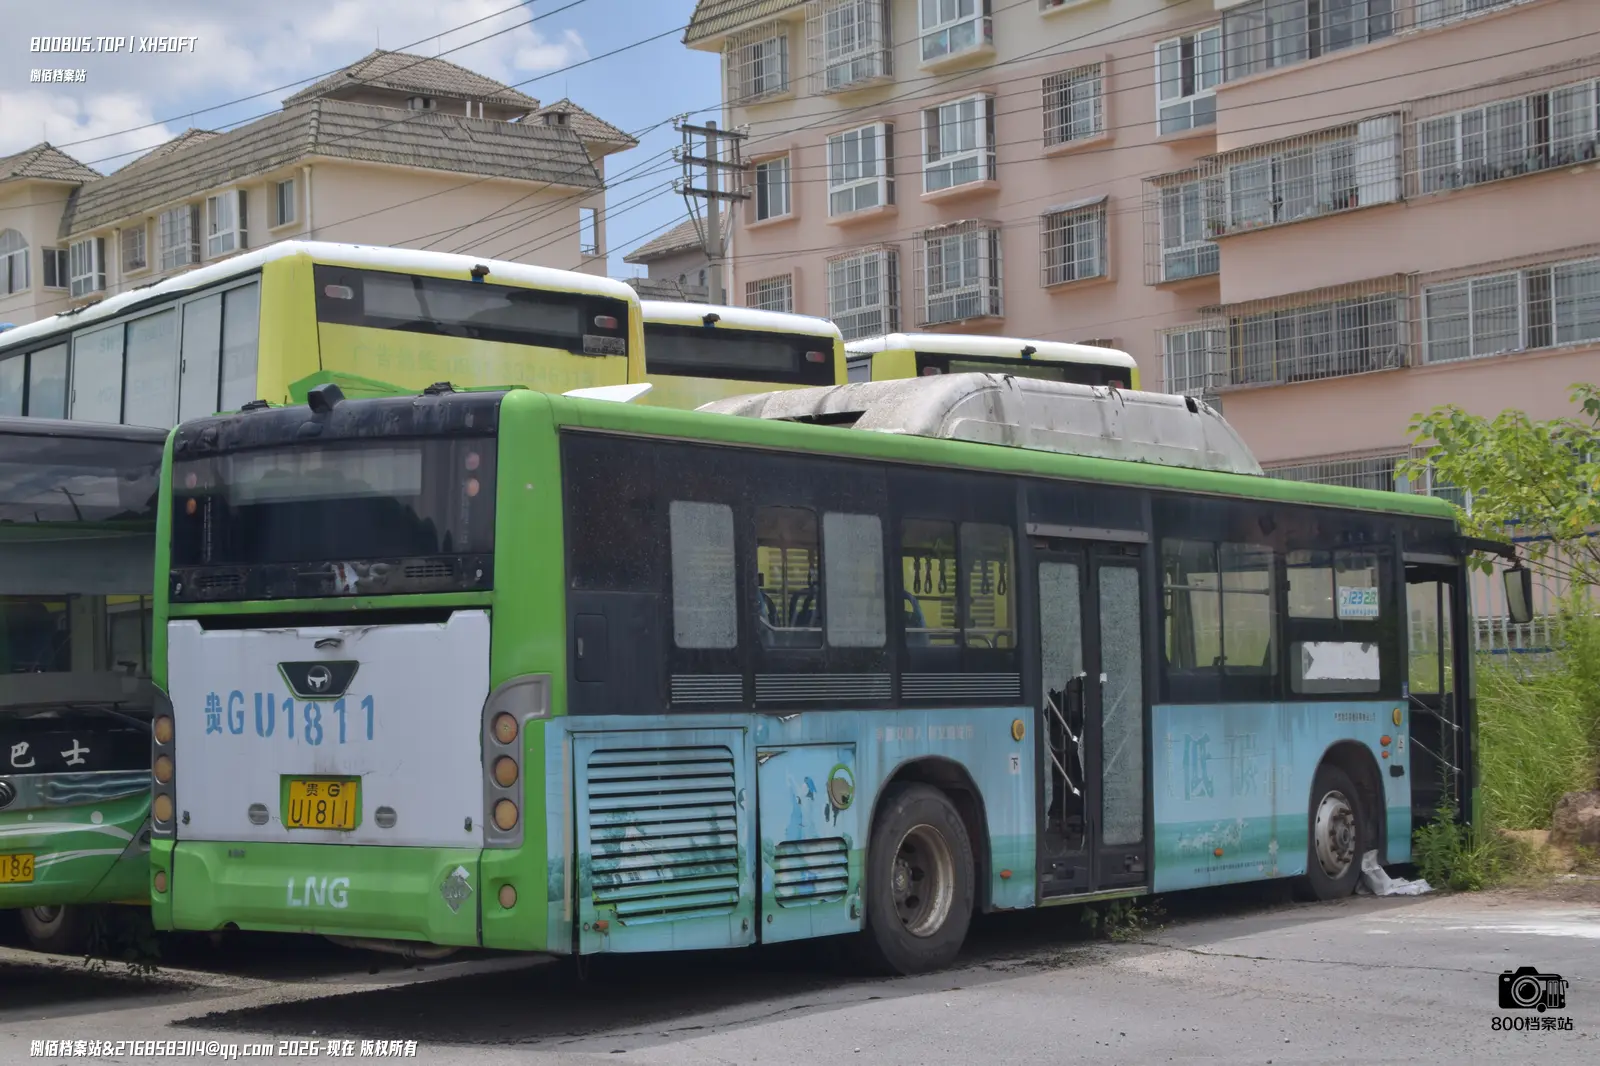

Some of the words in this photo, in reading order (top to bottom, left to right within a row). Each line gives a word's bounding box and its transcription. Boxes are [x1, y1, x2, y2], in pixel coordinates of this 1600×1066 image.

[205, 690, 374, 746] 贵GU1811
[11, 739, 91, 768] 巴士
[1010, 757, 1019, 770] 下
[291, 799, 348, 826] U1811
[287, 876, 350, 909] LNG
